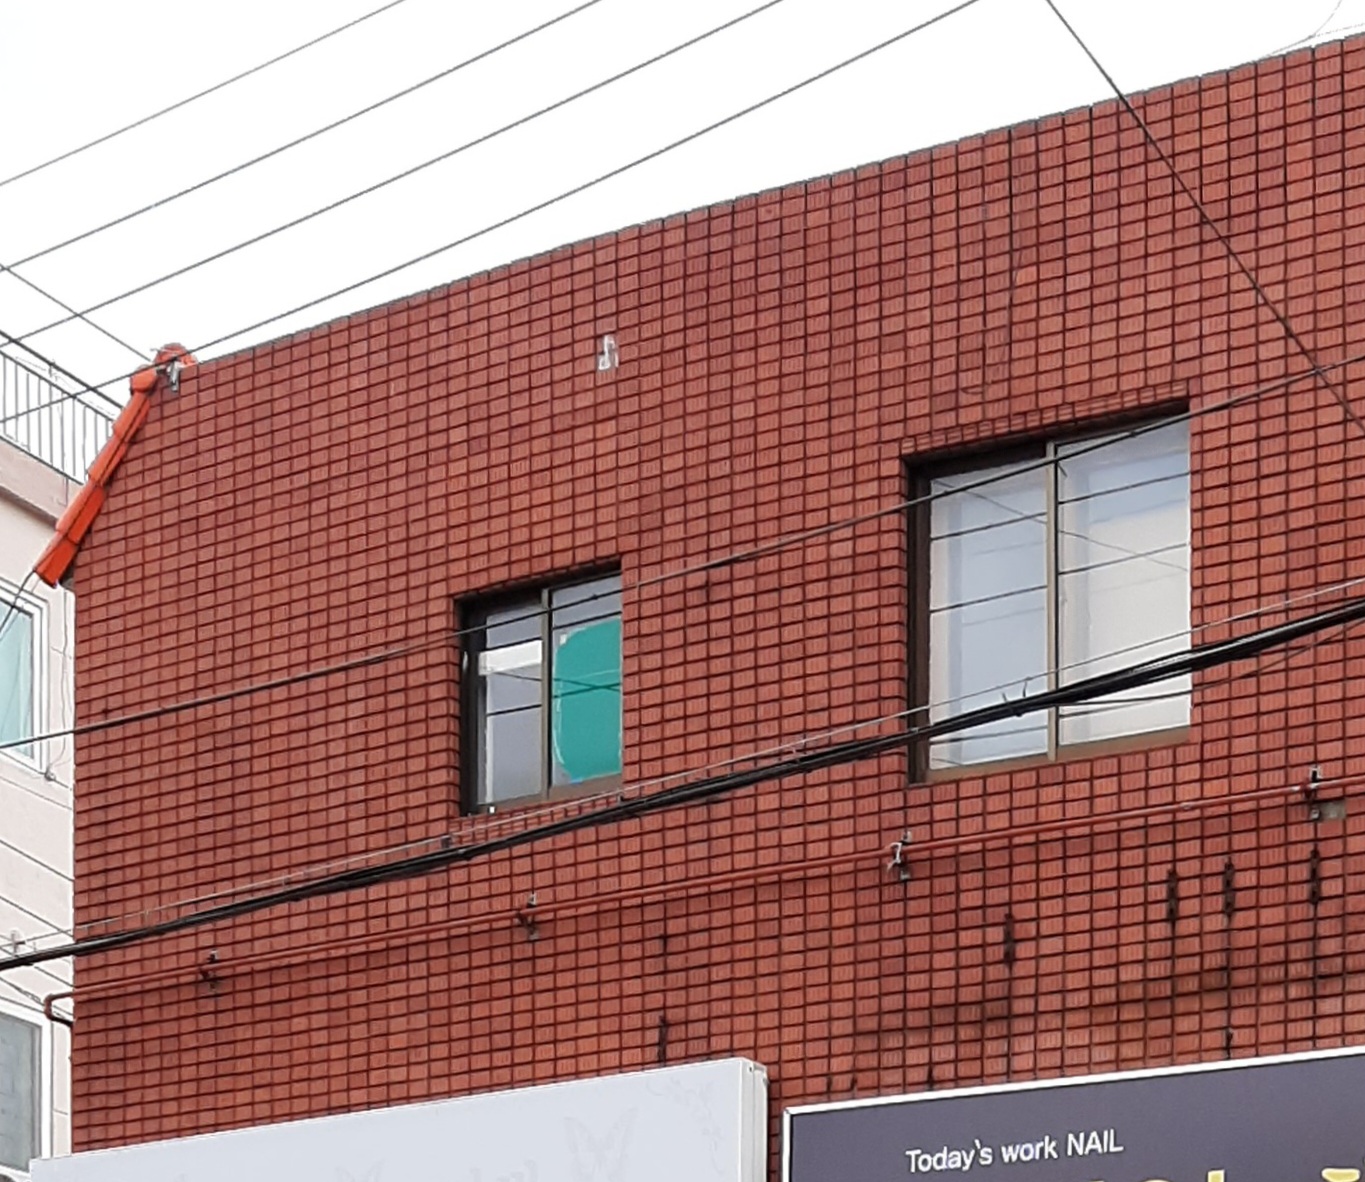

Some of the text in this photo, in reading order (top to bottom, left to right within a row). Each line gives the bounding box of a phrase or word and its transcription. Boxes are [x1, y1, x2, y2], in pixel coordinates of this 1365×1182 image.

[906, 1129, 1124, 1172] Today's work NAIL
